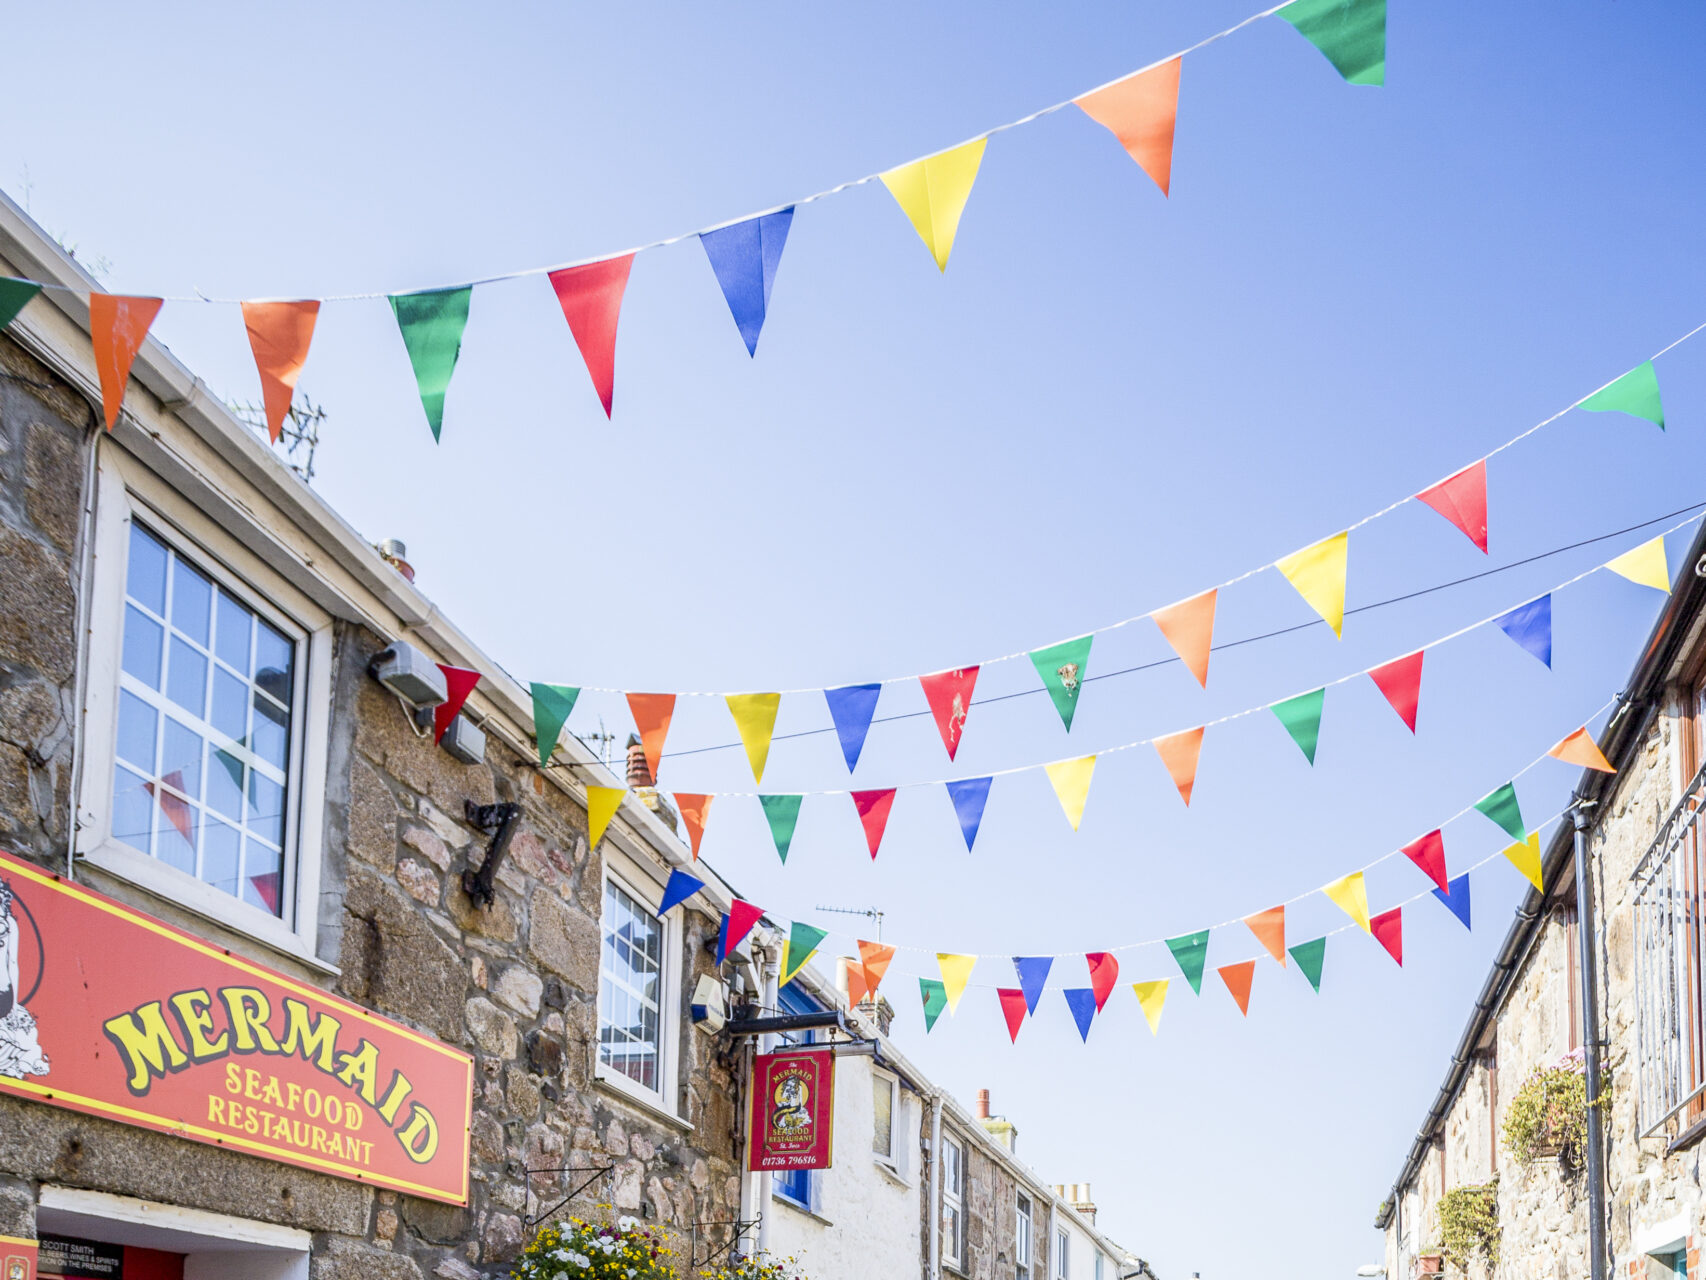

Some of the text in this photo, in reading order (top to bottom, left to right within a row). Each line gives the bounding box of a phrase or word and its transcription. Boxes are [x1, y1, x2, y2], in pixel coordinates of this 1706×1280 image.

[104, 986, 439, 1164] MERMAID
[772, 1068, 813, 1084] MERMAID
[226, 1062, 364, 1131] SEAFOOD
[208, 1095, 375, 1166] RESTAURANT
[772, 1127, 809, 1136] SEAFOOD
[768, 1135, 812, 1143] RESTAURANT
[762, 1155, 817, 1166] 01736 796816
[42, 1241, 94, 1255] SCOTT SMITH
[70, 1253, 89, 1262] WINES
[96, 1257, 119, 1266] SPIRITS
[69, 1261, 80, 1269] THE
[82, 1263, 112, 1273] PREMISES
